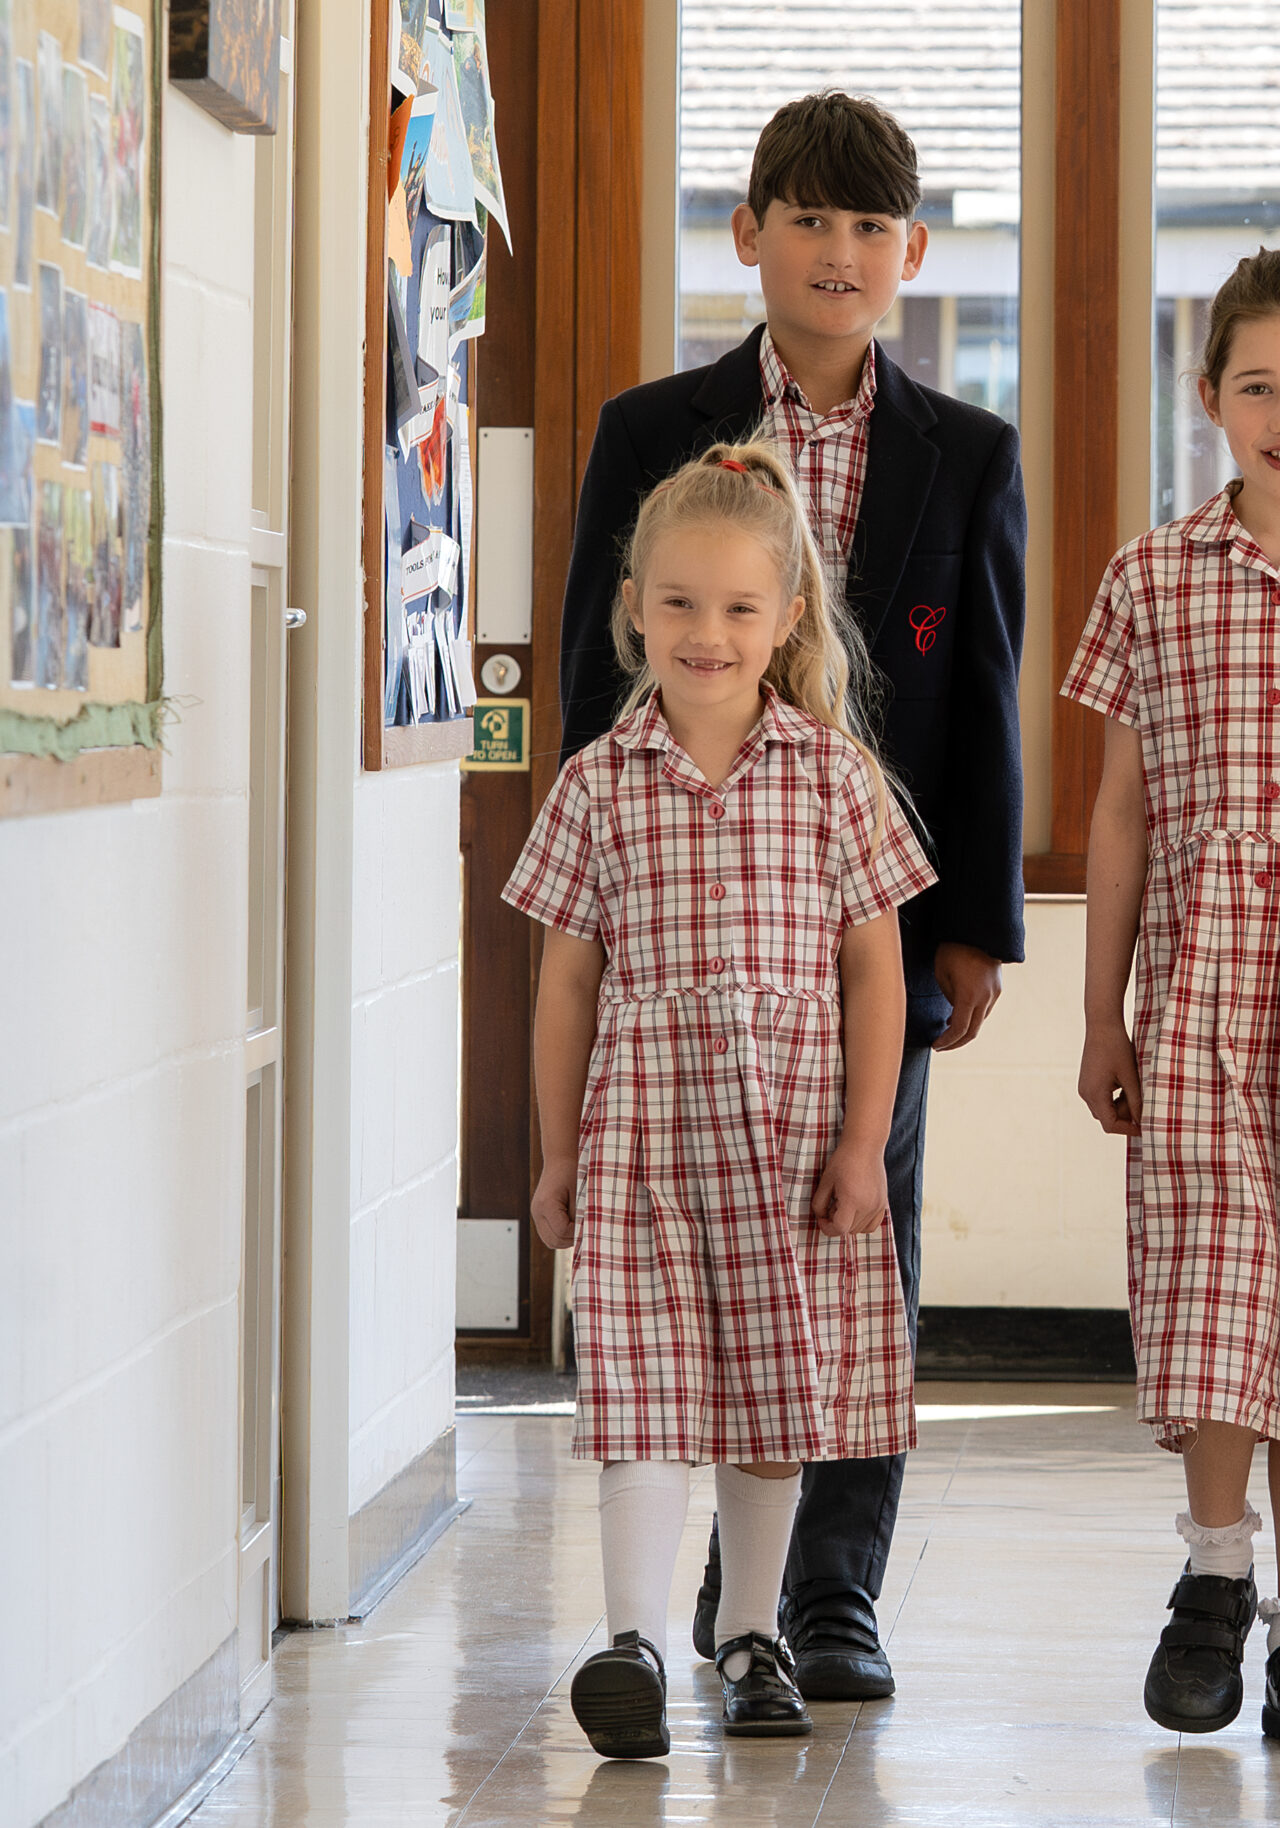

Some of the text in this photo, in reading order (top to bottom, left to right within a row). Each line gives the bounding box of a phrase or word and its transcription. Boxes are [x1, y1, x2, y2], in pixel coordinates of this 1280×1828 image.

[430, 306, 447, 325] your
[406, 560, 424, 575] TOOLS
[481, 740, 509, 750] TURN
[473, 750, 517, 760] TO OPEN
